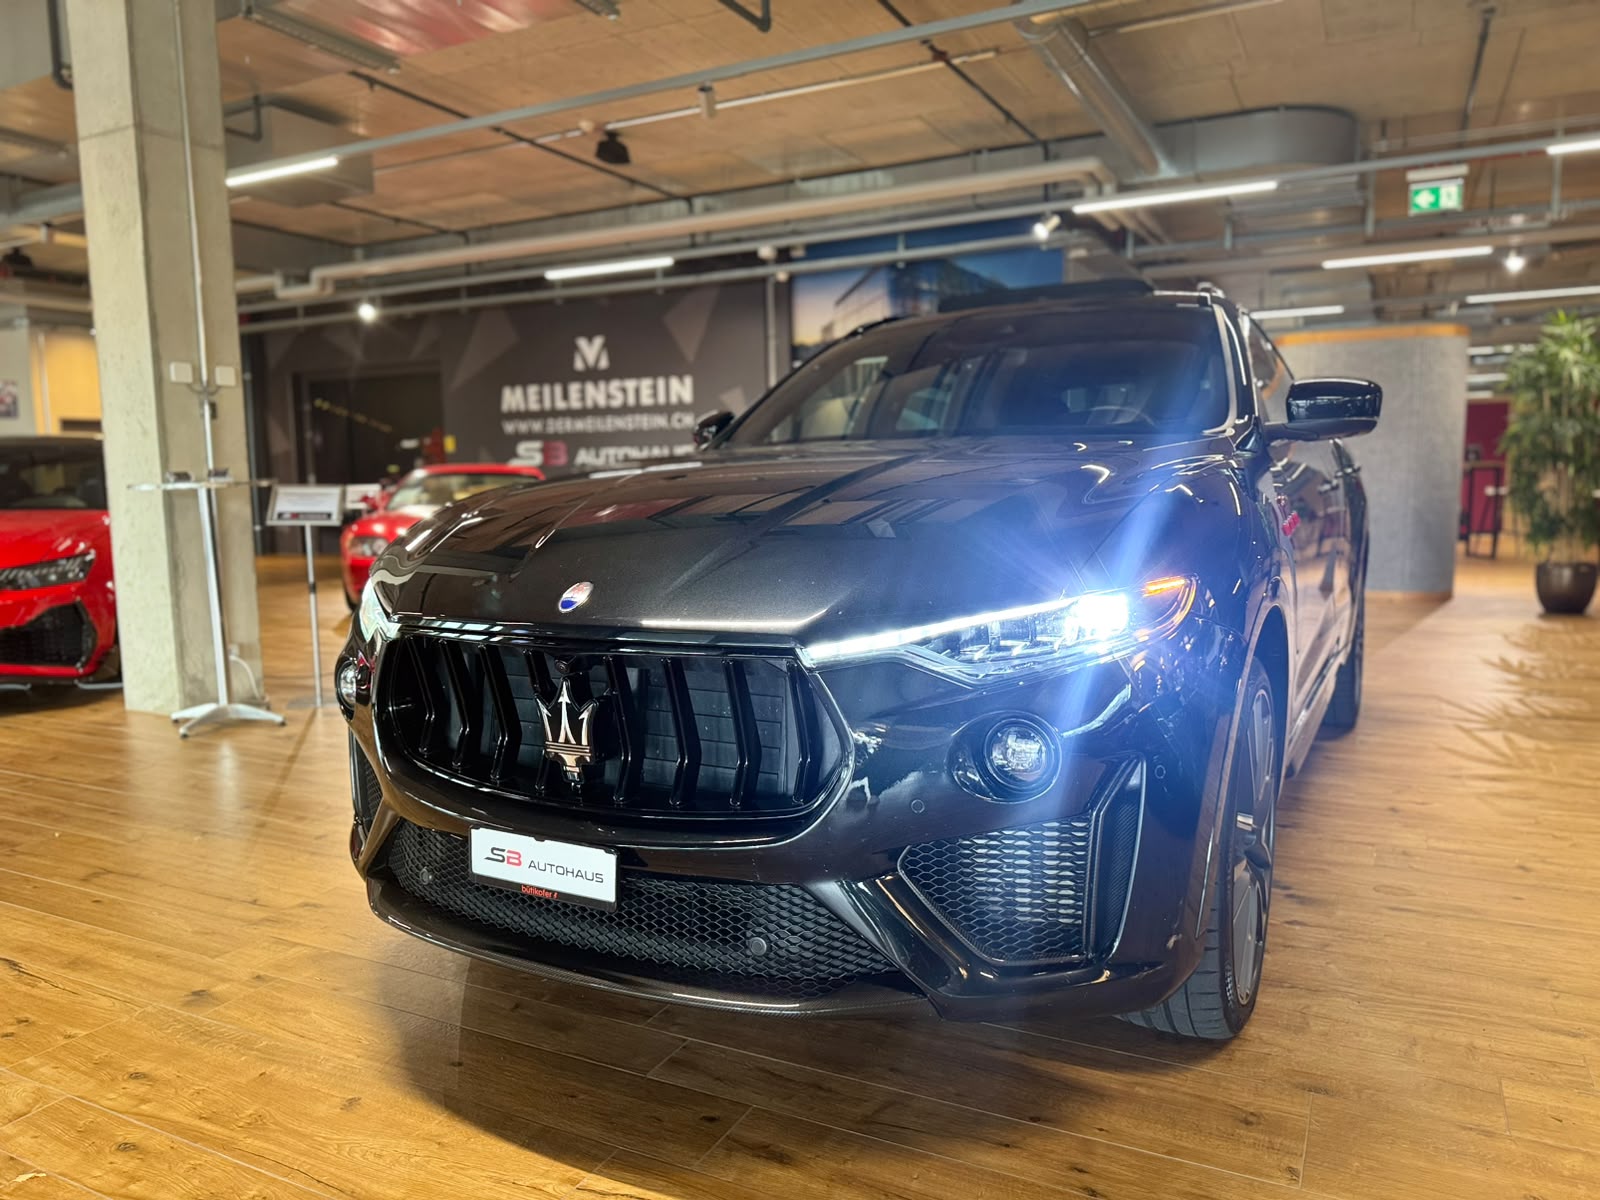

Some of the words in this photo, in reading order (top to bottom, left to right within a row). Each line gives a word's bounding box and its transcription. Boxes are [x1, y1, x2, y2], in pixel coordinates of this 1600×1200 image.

[501, 374, 694, 413] MEILENSTEIN
[508, 440, 568, 467] SB
[484, 846, 522, 867] SB
[528, 859, 604, 884] AUTOHAUS
[521, 884, 553, 899] bütikofer
